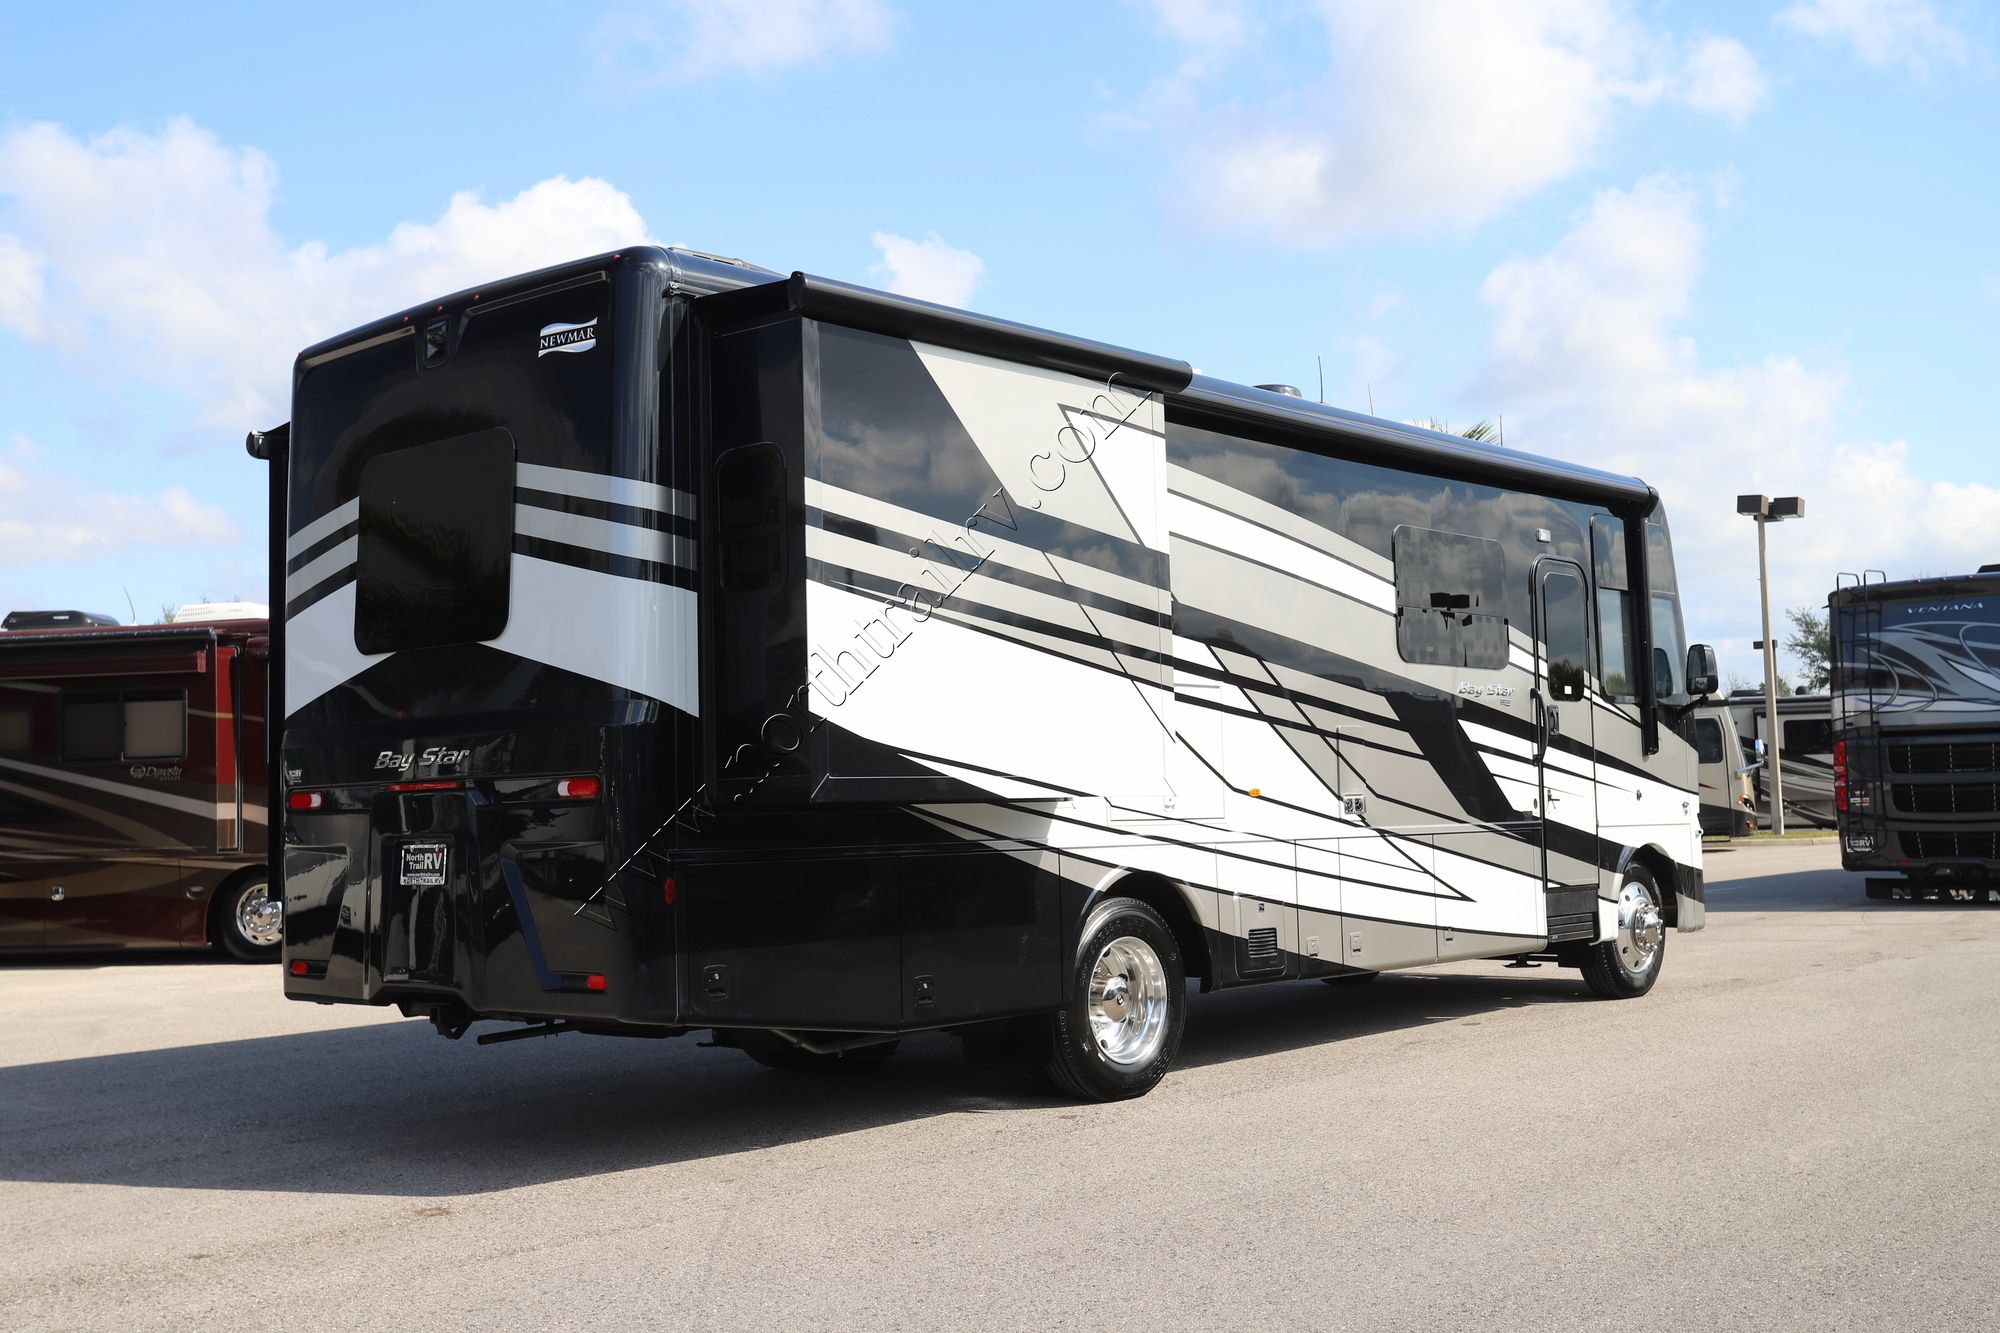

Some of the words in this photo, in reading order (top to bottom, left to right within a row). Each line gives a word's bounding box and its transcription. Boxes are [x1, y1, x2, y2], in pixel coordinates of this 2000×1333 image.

[539, 327, 595, 349] NEWMAR
[1907, 602, 1984, 614] VENTANA
[1457, 680, 1483, 698] Bay
[1487, 684, 1516, 697] Star
[374, 750, 416, 772] Bay
[419, 746, 470, 766] Star
[406, 852, 424, 862] North
[409, 862, 424, 870] Trail
[424, 852, 443, 870] RV
